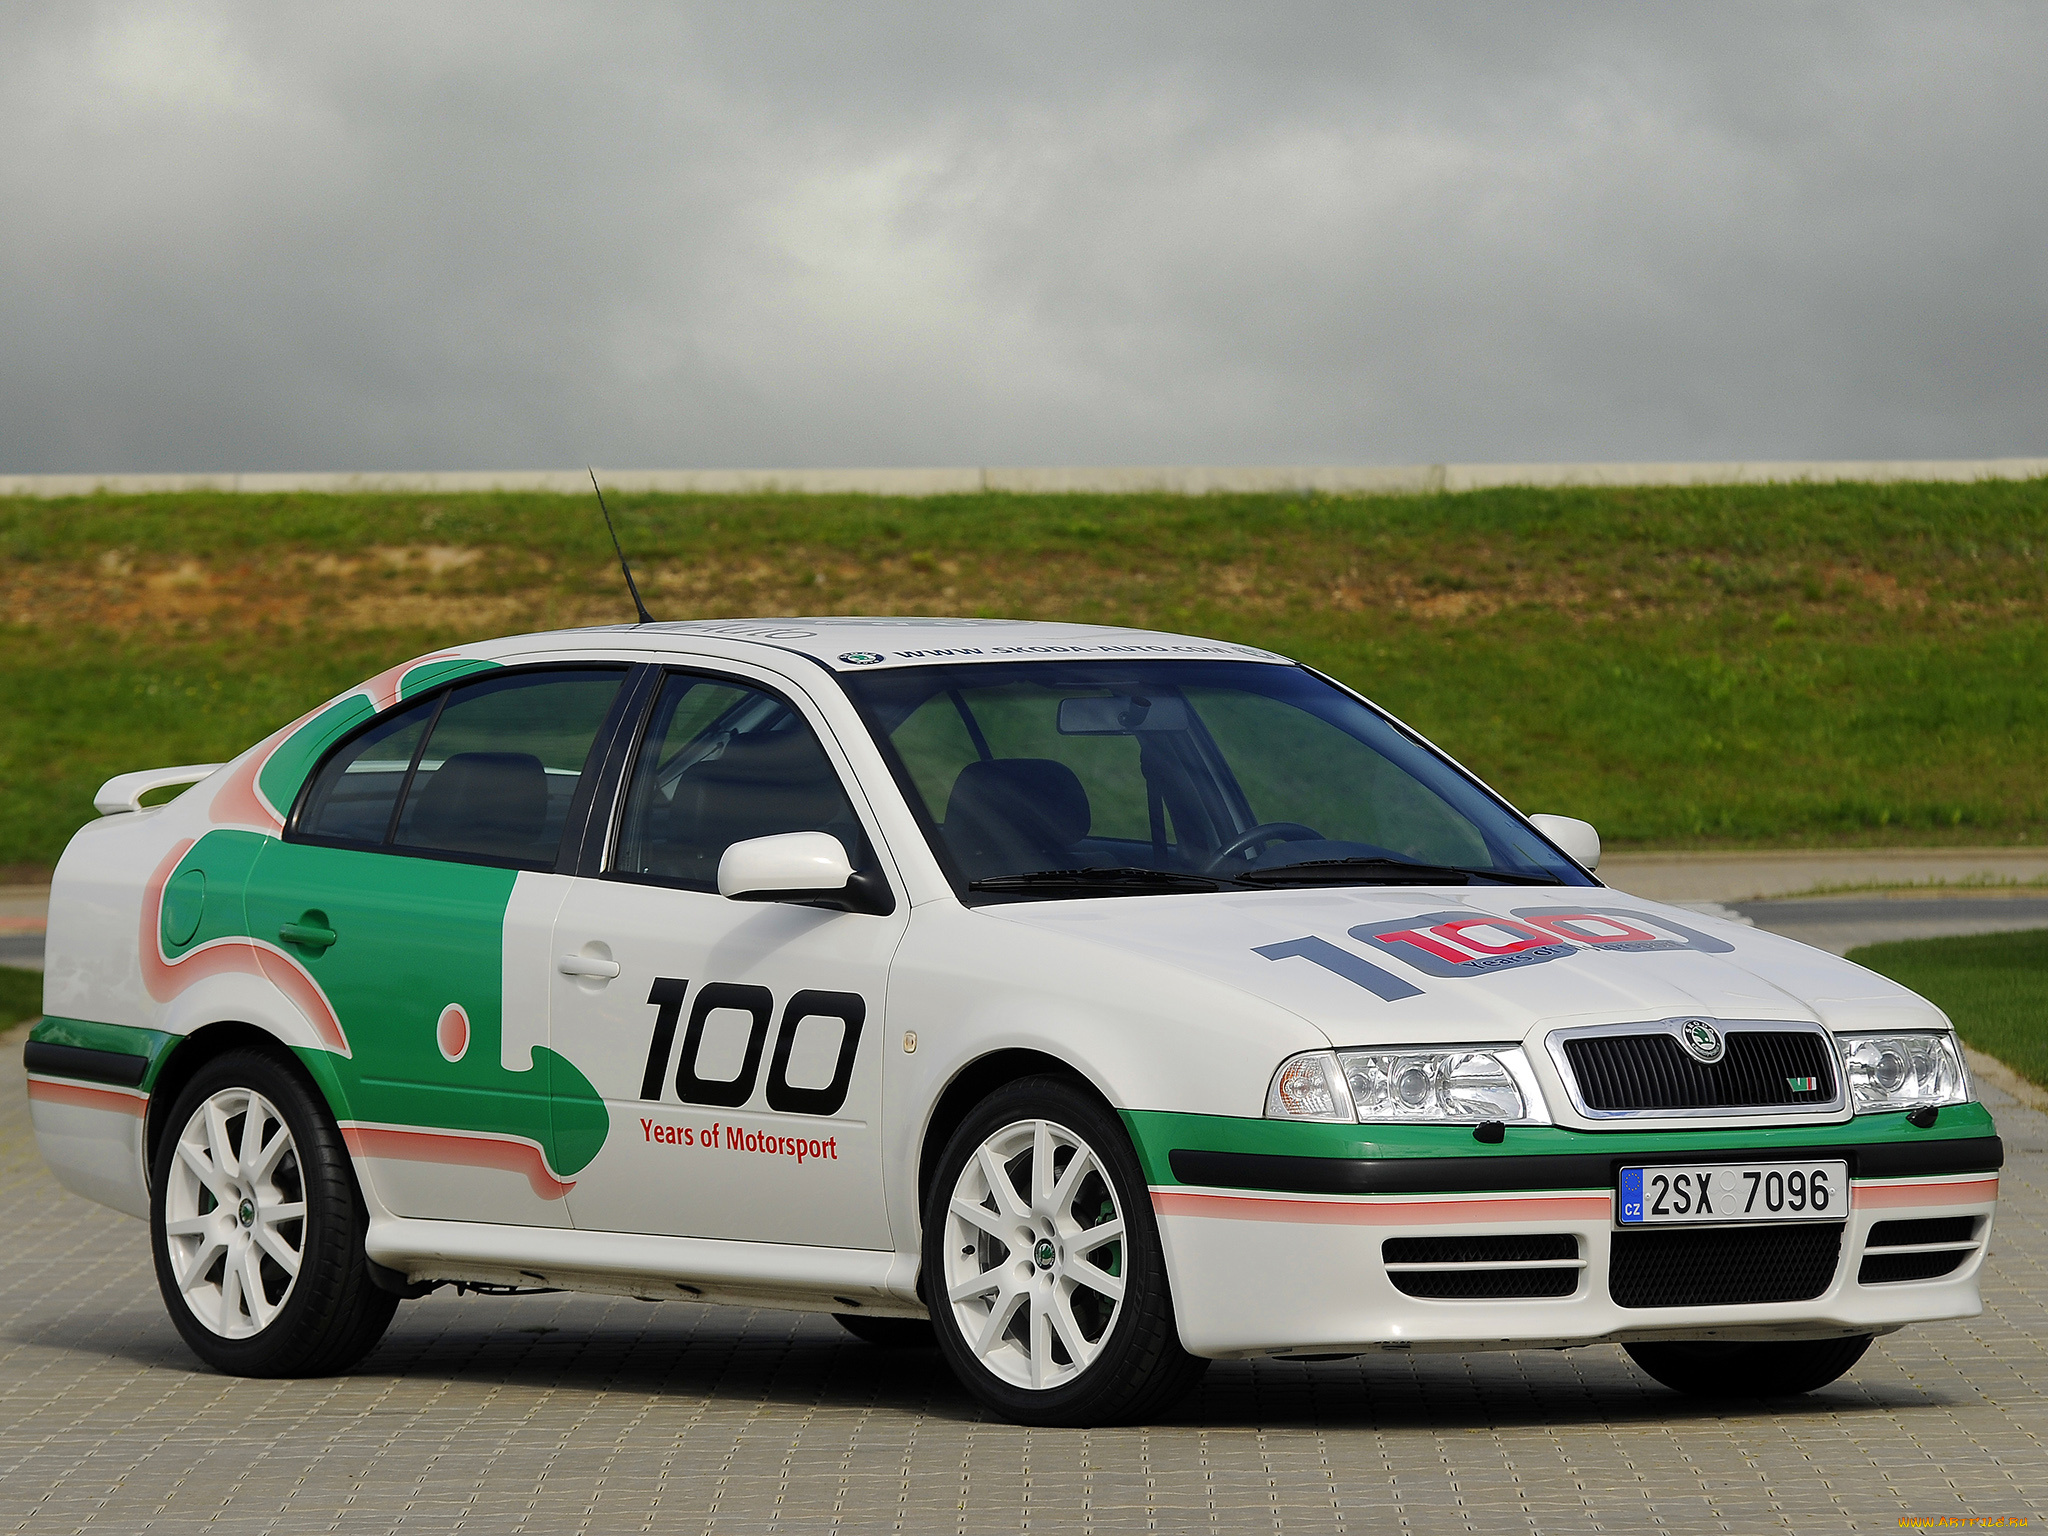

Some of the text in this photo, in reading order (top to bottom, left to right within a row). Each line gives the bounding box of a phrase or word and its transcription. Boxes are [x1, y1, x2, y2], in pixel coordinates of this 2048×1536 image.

[1462, 954, 1534, 970] Years
[639, 976, 867, 1116] 100
[640, 1118, 838, 1164] Years of Motorsport
[1625, 1203, 1641, 1216] CZ
[1651, 1170, 1829, 1215] 2SX 7096
